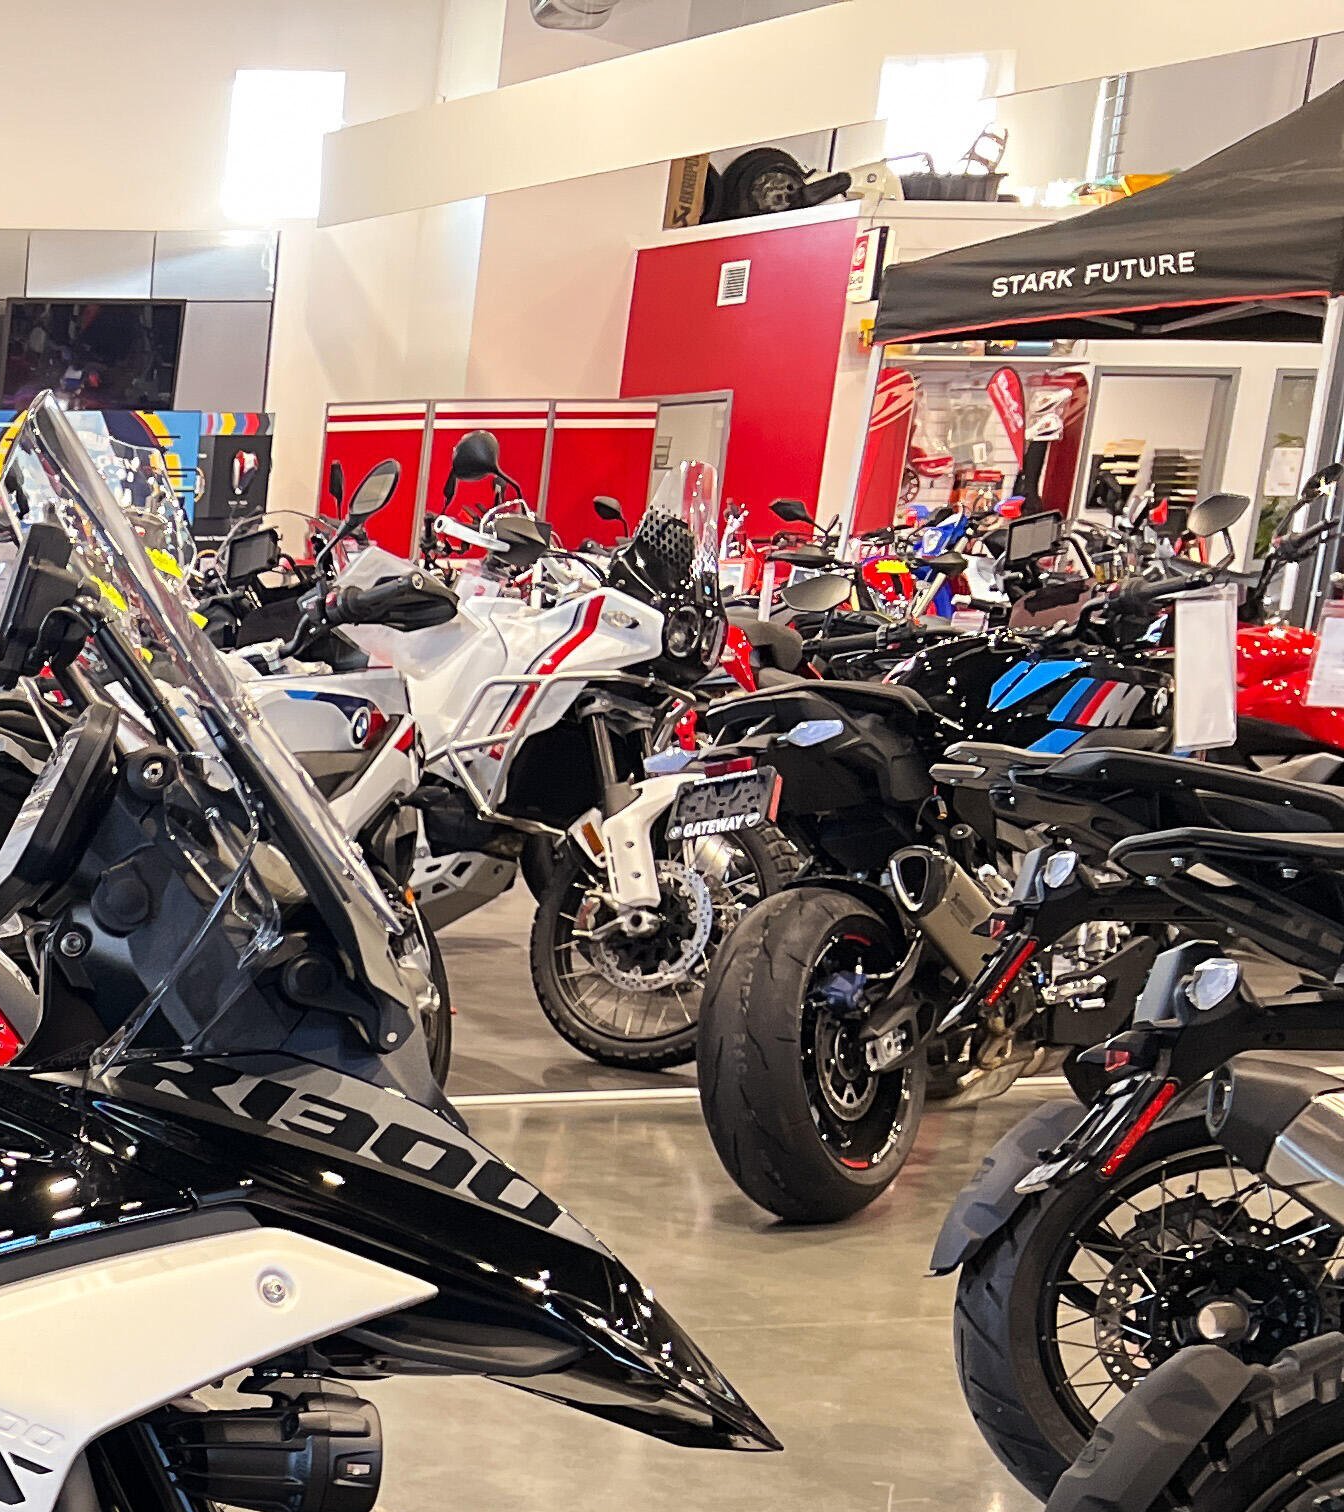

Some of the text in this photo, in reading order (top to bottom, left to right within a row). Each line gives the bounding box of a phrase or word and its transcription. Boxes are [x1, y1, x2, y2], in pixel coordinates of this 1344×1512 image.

[991, 250, 1196, 298] STARK FUTURE
[683, 814, 745, 838] GATEWAY
